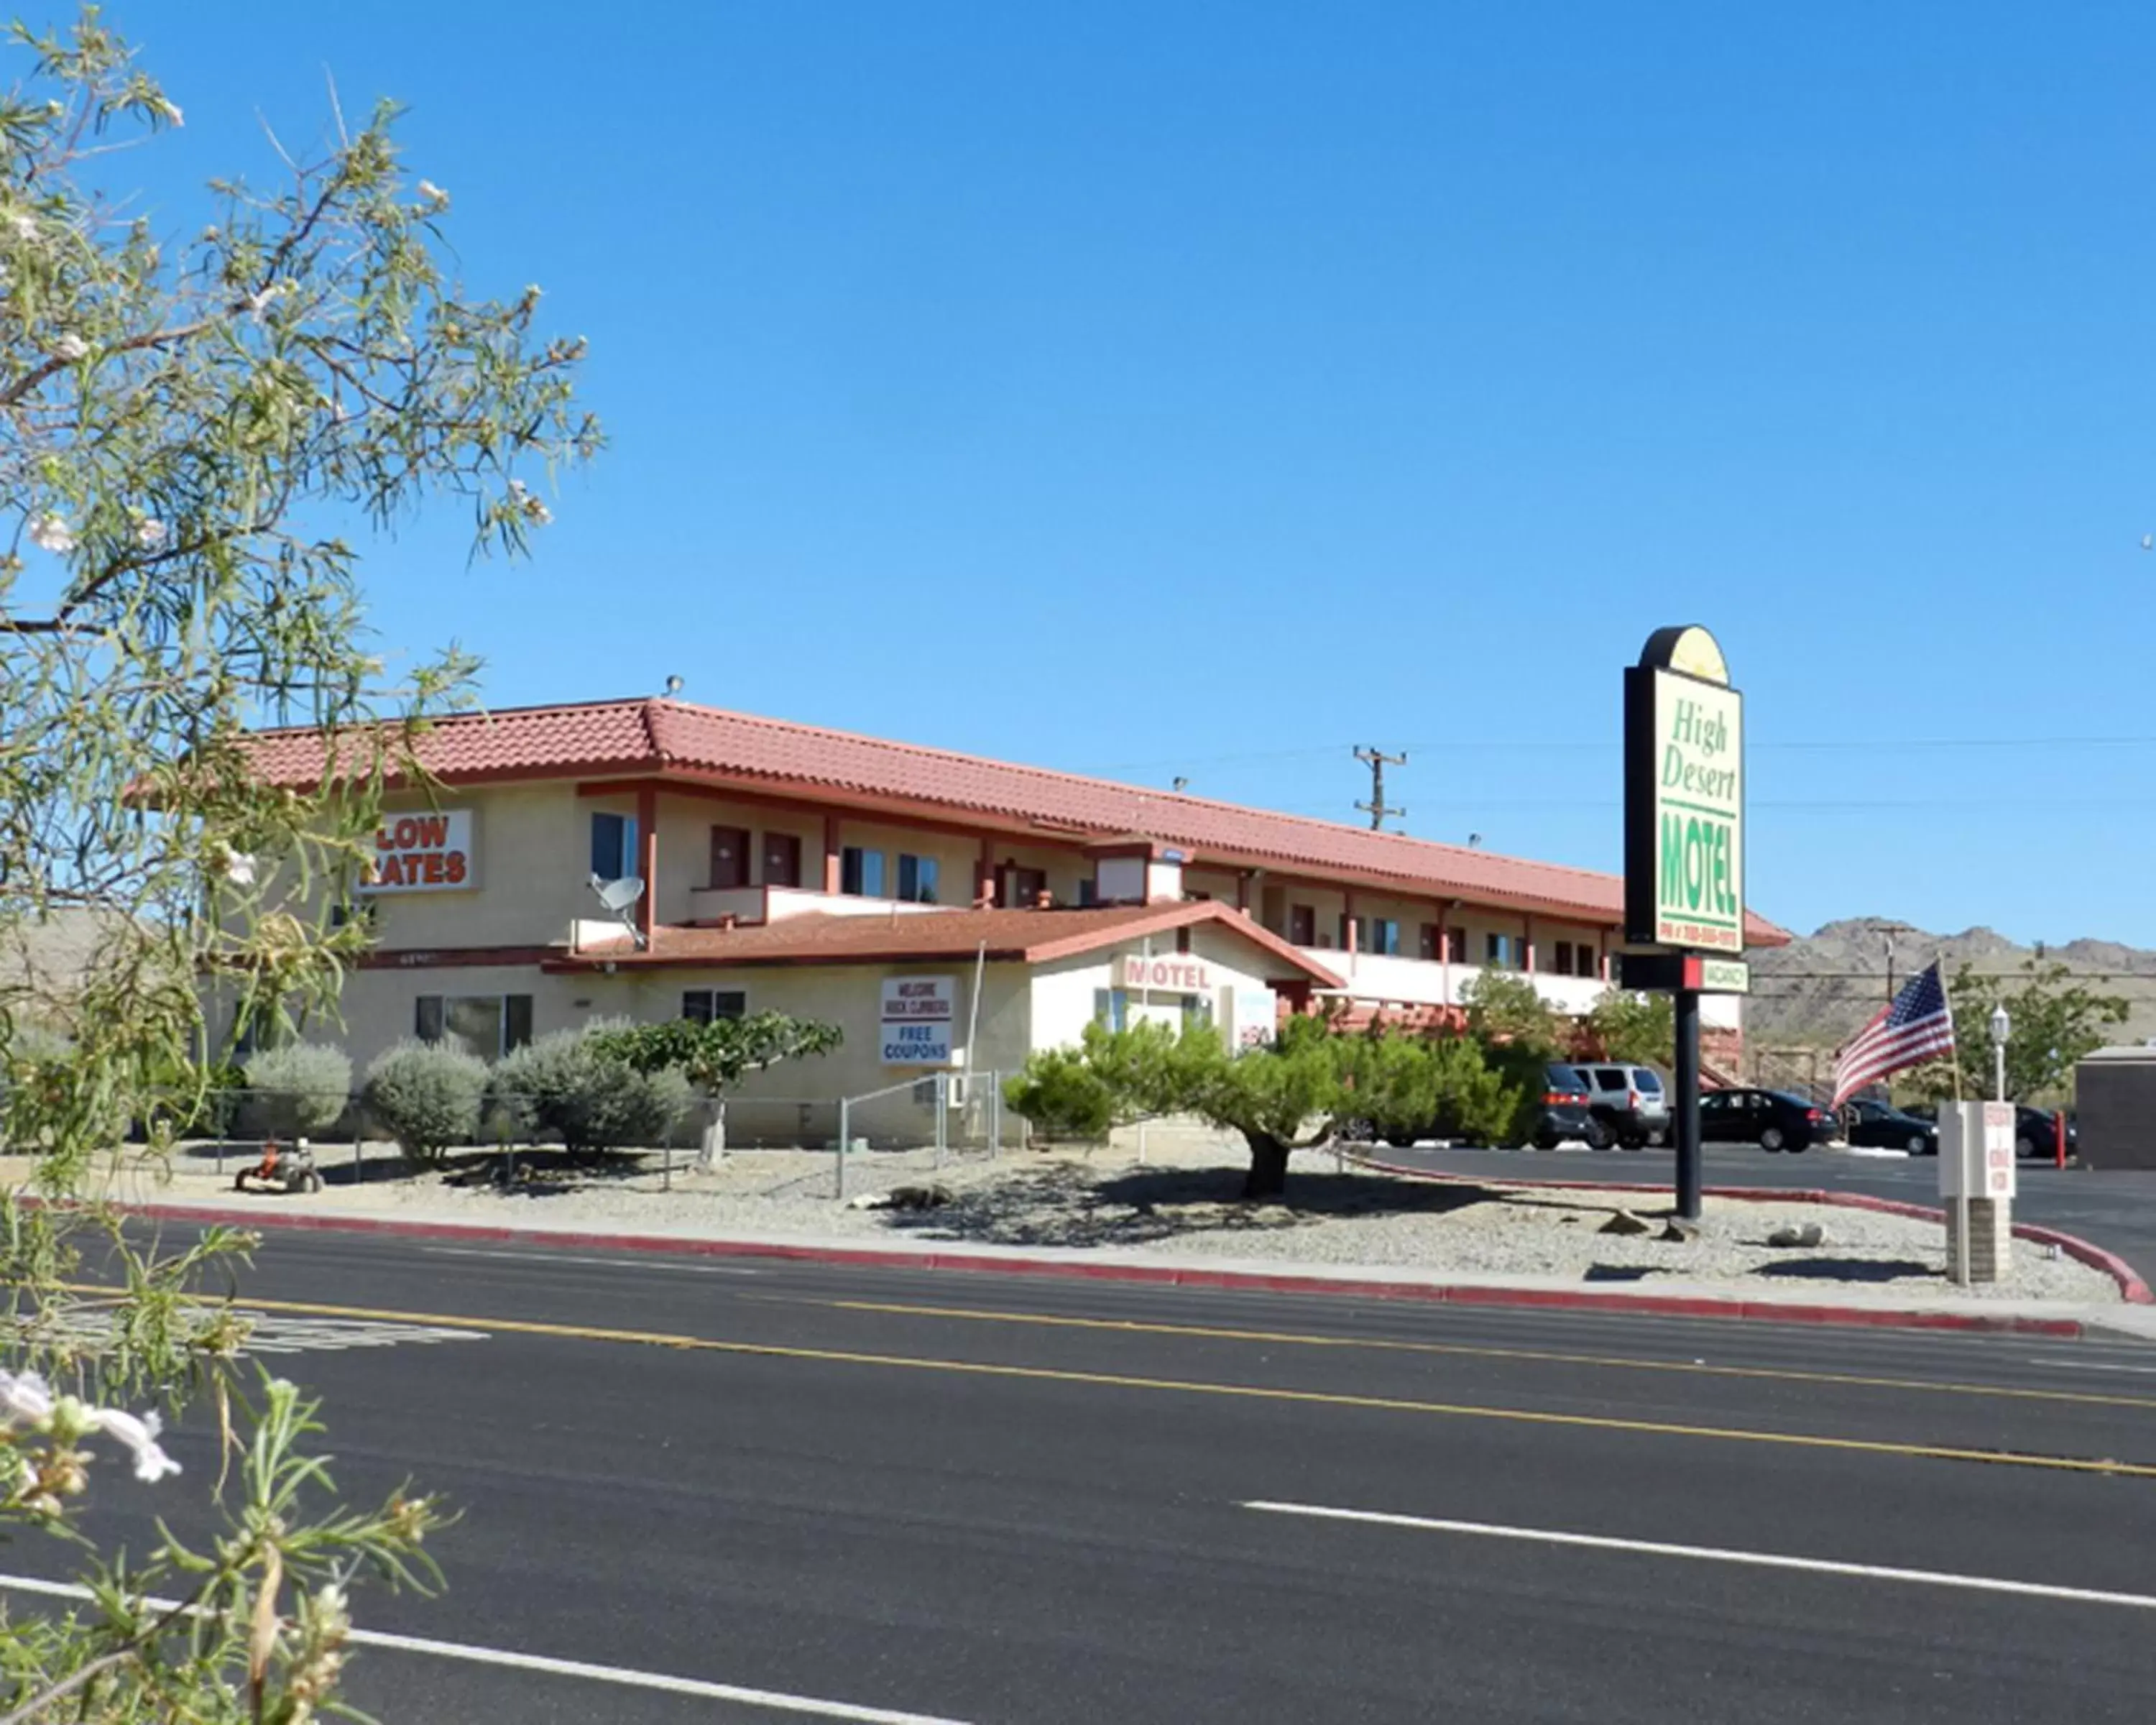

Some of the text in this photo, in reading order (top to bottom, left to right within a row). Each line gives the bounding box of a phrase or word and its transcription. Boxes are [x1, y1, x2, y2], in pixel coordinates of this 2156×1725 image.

[1672, 699, 1727, 756] High
[1661, 745, 1736, 801] Desert
[376, 816, 449, 850] LOW
[1660, 811, 1737, 916] MOTEL
[1127, 960, 1212, 990] MOTEL
[899, 1026, 931, 1041] FREE
[884, 1043, 947, 1059] COUPONS
